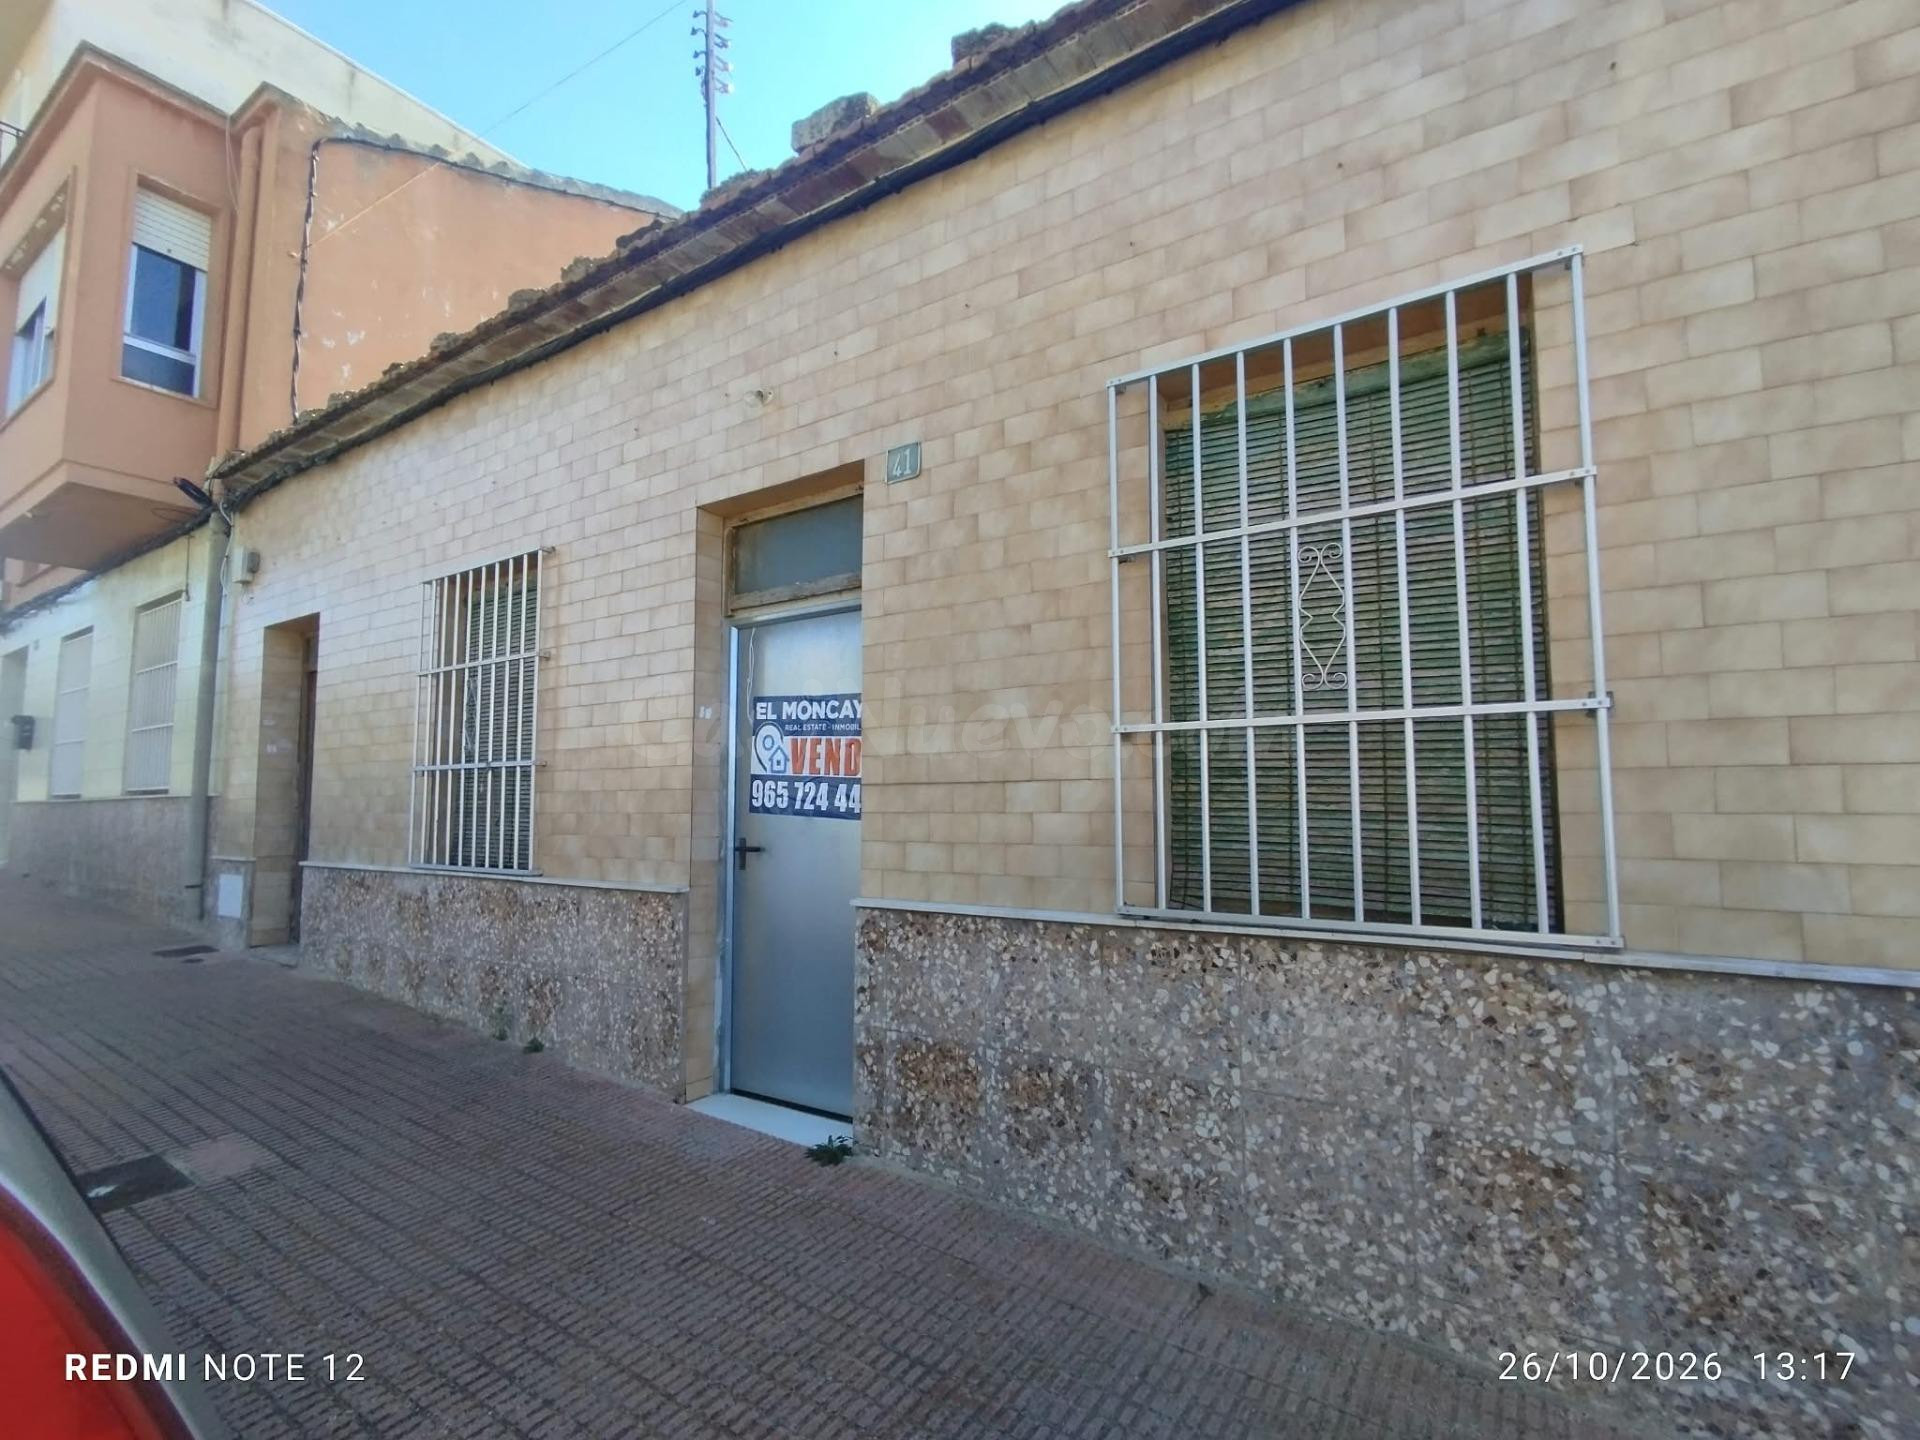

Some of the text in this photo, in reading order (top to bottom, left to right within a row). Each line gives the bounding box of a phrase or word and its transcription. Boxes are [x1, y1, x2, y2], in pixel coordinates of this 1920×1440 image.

[892, 448, 911, 477] 41
[756, 699, 862, 720] EL MONCAY
[784, 723, 801, 731] REAL
[803, 723, 827, 731] ESTATE
[790, 737, 862, 777] VEND
[752, 780, 861, 813] 965 724 44
